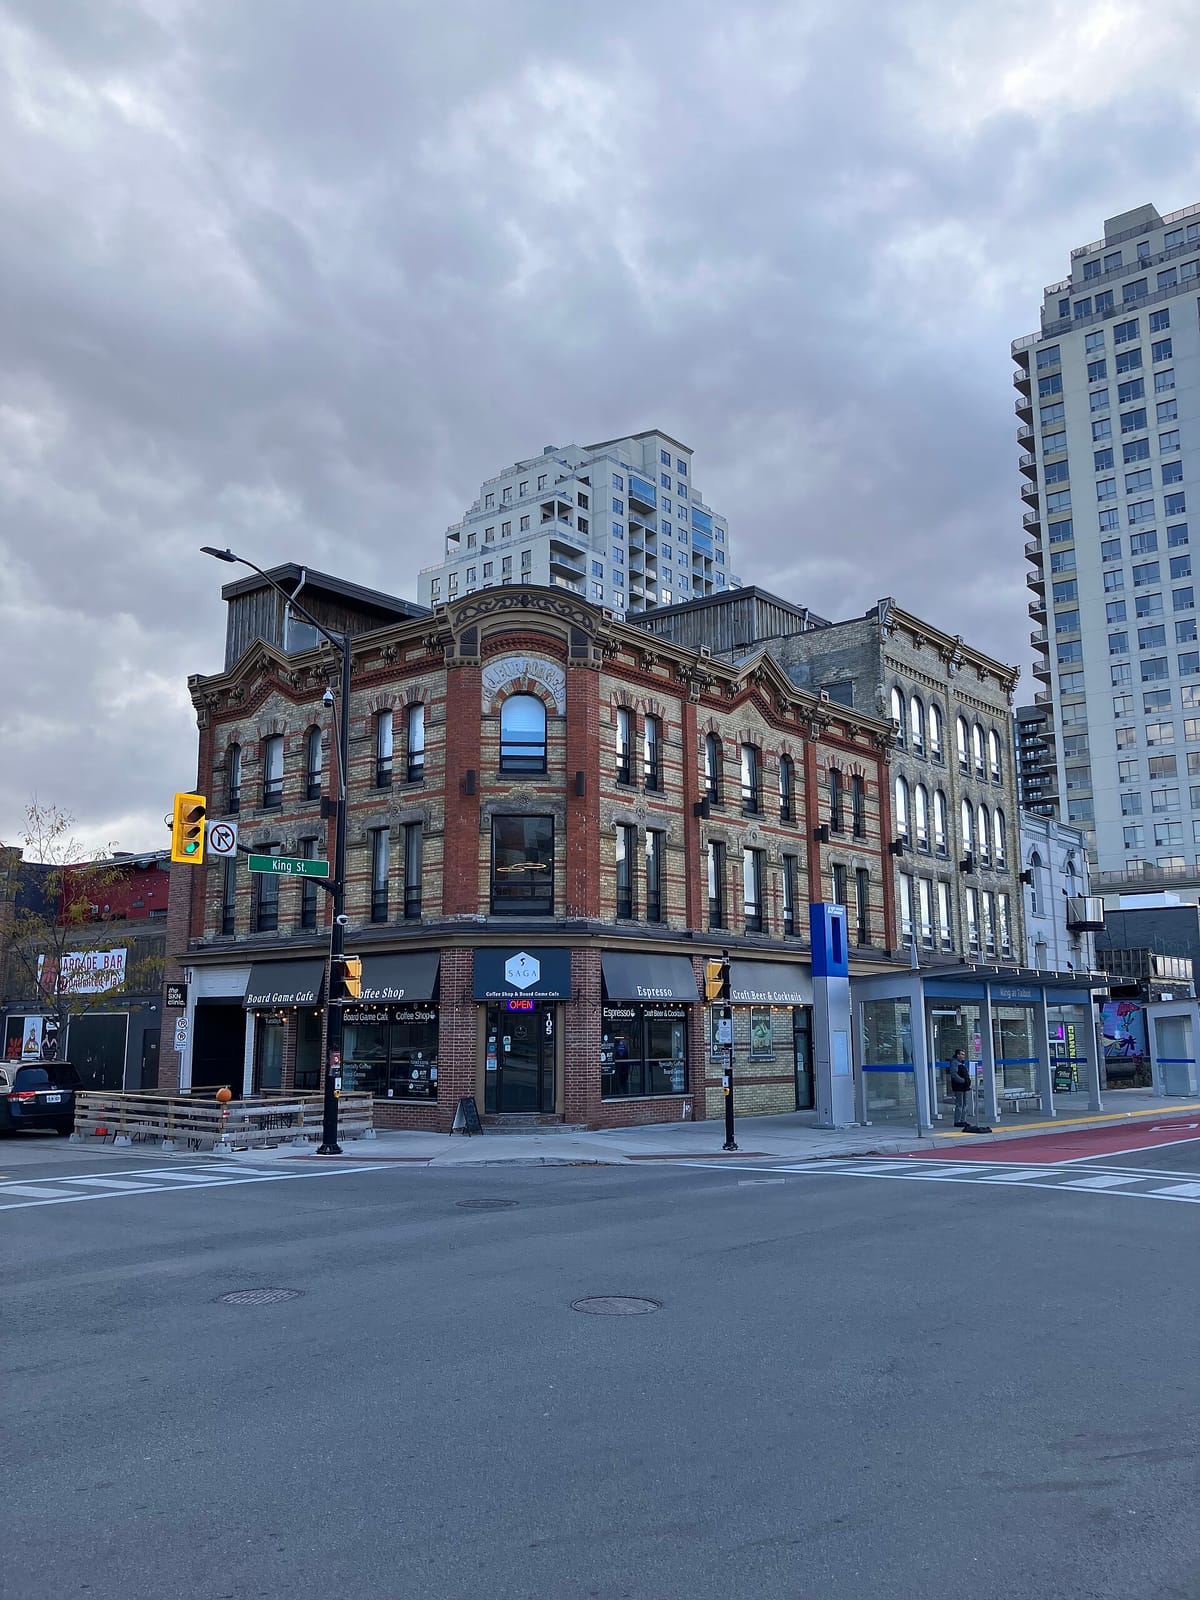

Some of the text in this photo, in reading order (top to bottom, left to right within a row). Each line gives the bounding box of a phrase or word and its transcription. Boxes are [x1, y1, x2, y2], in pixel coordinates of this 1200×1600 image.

[272, 859, 307, 873] King St.
[63, 954, 123, 972] ARCADE BAR
[246, 990, 314, 1004] Board Game Cafe
[359, 987, 405, 1000] offee Shop
[636, 986, 673, 999] Espresso
[732, 990, 802, 1002] Craft Beer & Cocktails
[509, 1000, 533, 1009] OPEN
[343, 1013, 359, 1021] Board
[359, 1012, 376, 1021] Game
[396, 1012, 429, 1022] Coffee Shop
[603, 1007, 631, 1019] Espresso
[545, 1012, 553, 1035] 105
